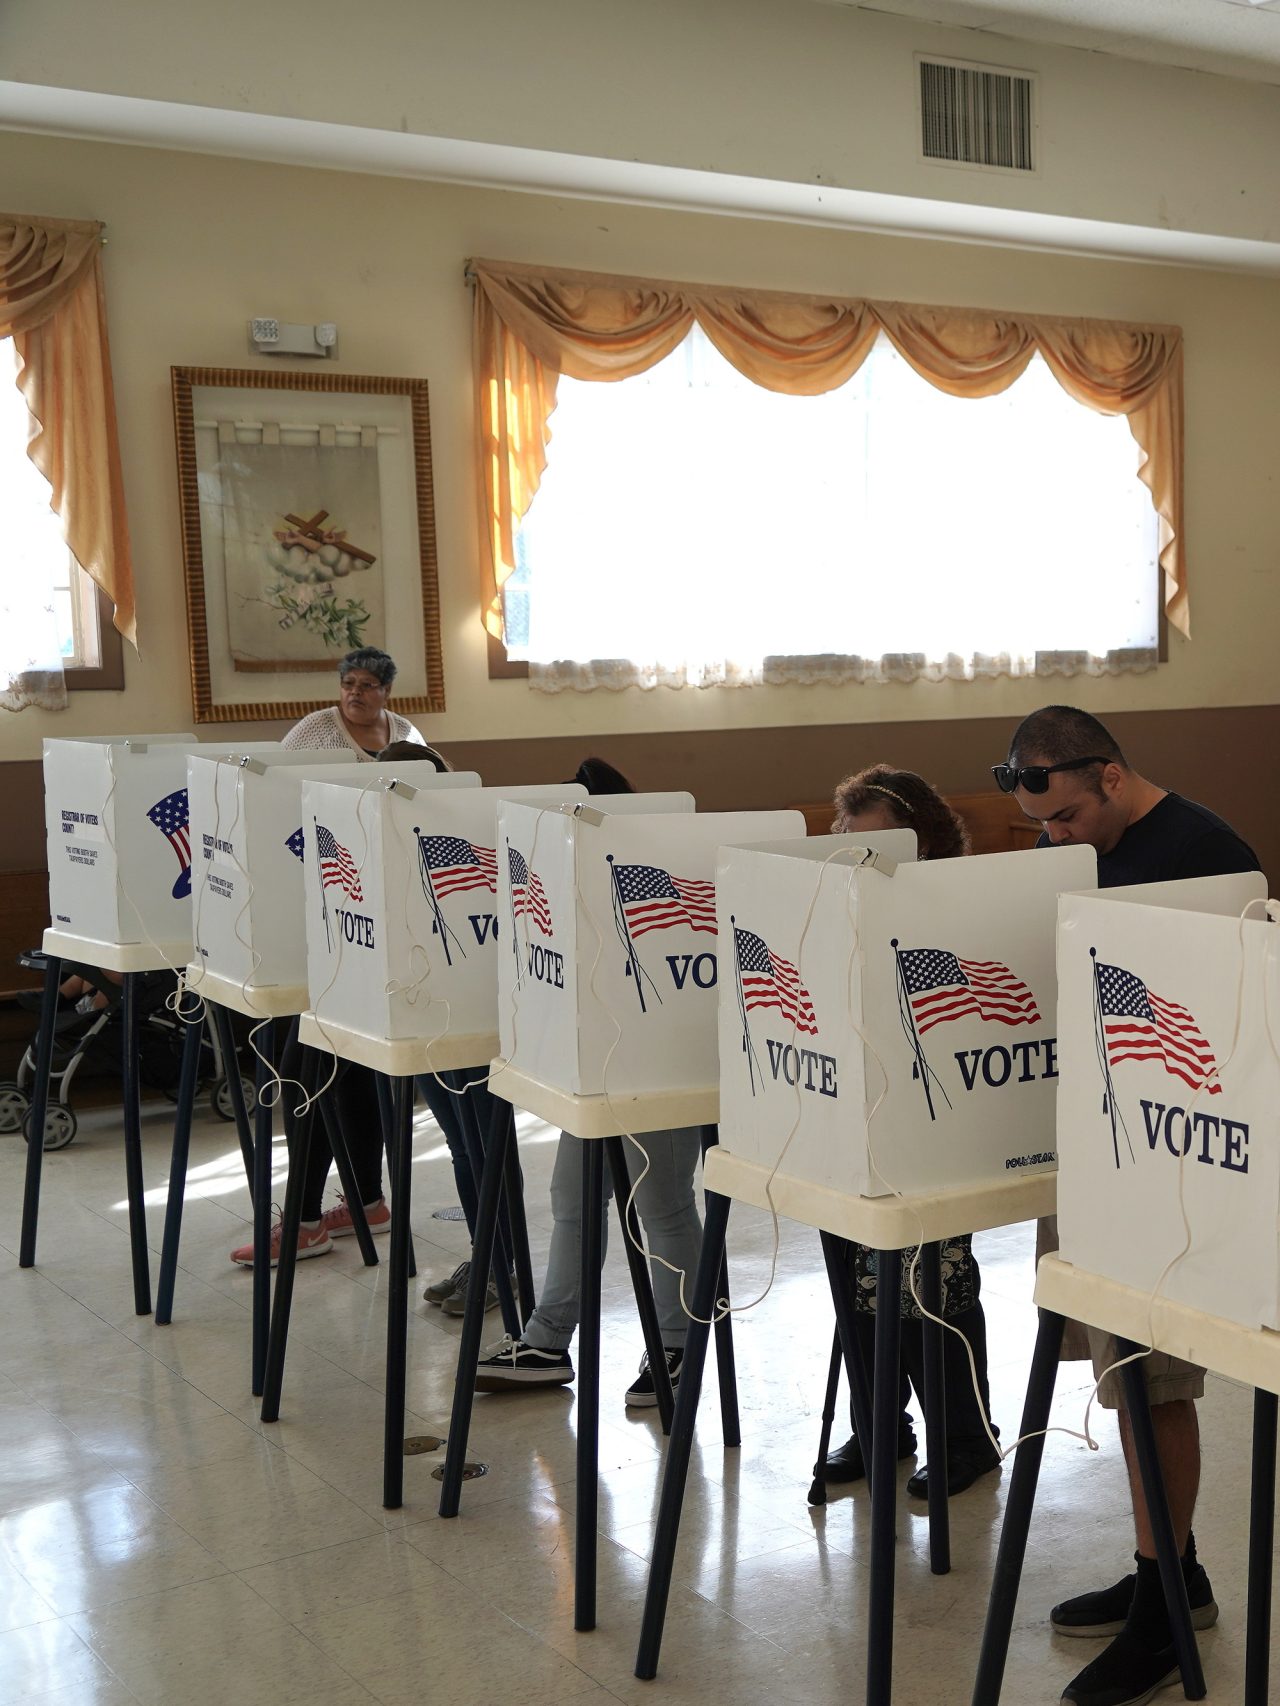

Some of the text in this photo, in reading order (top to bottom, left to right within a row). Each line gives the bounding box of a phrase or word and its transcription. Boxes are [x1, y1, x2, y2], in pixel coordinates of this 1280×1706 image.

[85, 814, 99, 826] VOTERS
[766, 1039, 838, 1099] VOTE
[1139, 1099, 1249, 1174] VOTE
